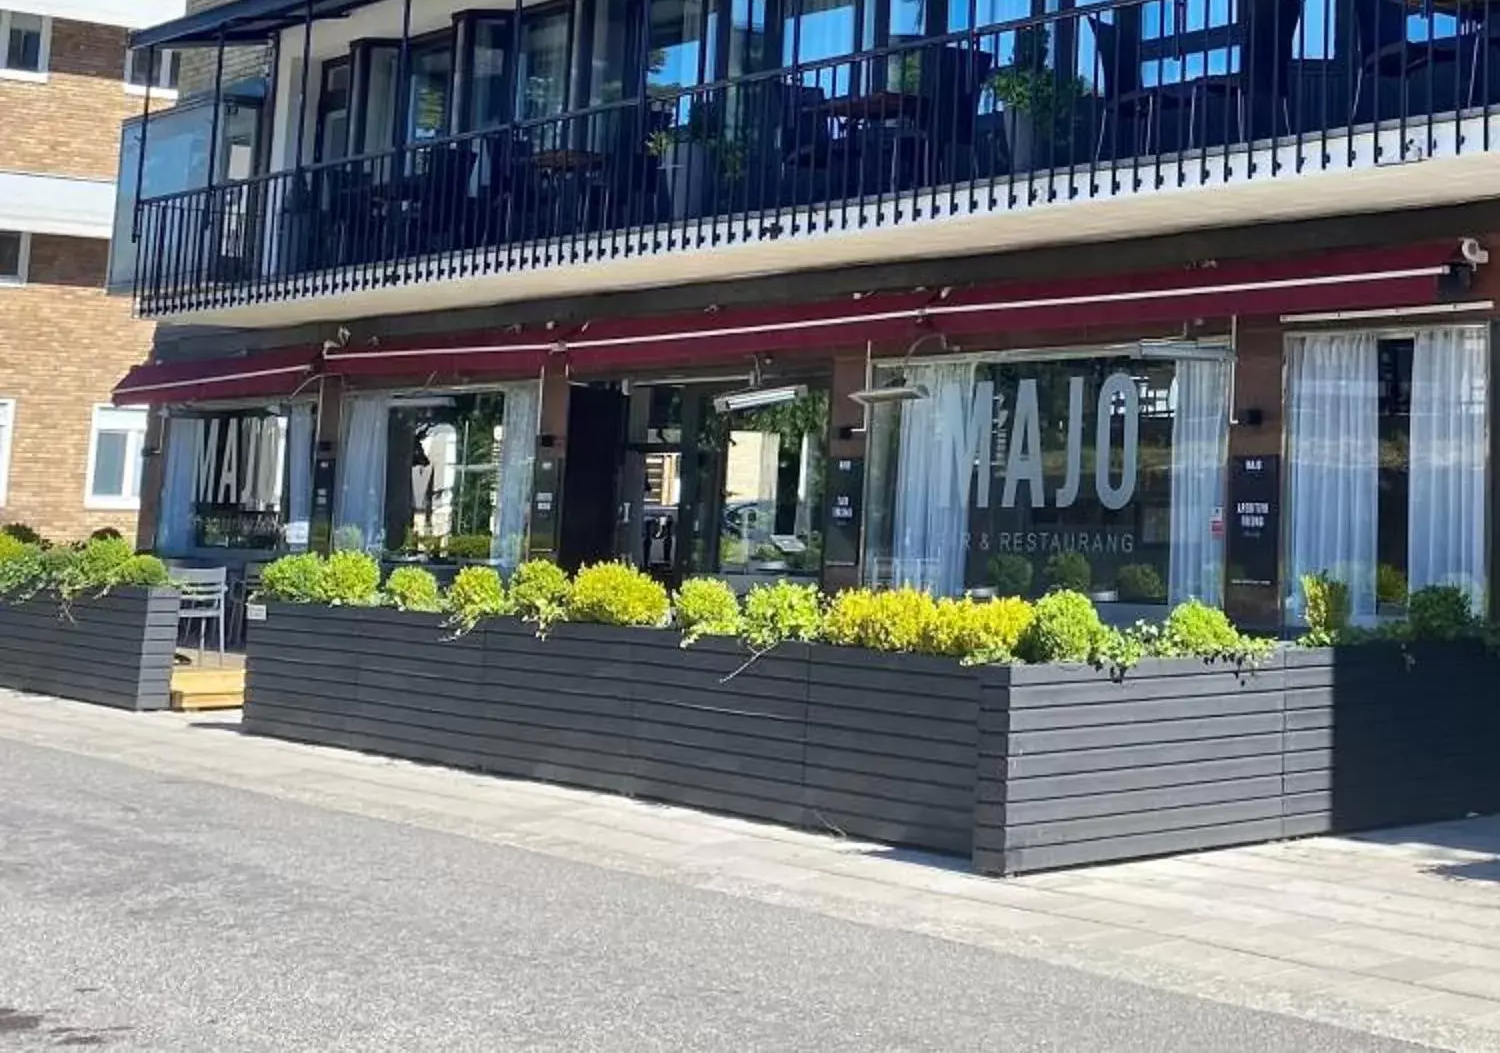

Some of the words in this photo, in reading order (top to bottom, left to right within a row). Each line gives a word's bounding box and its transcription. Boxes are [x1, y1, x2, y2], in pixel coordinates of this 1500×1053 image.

[190, 416, 285, 504] MAJ
[936, 372, 1139, 510] MAJO
[1000, 532, 1135, 552] RESTAURANG
